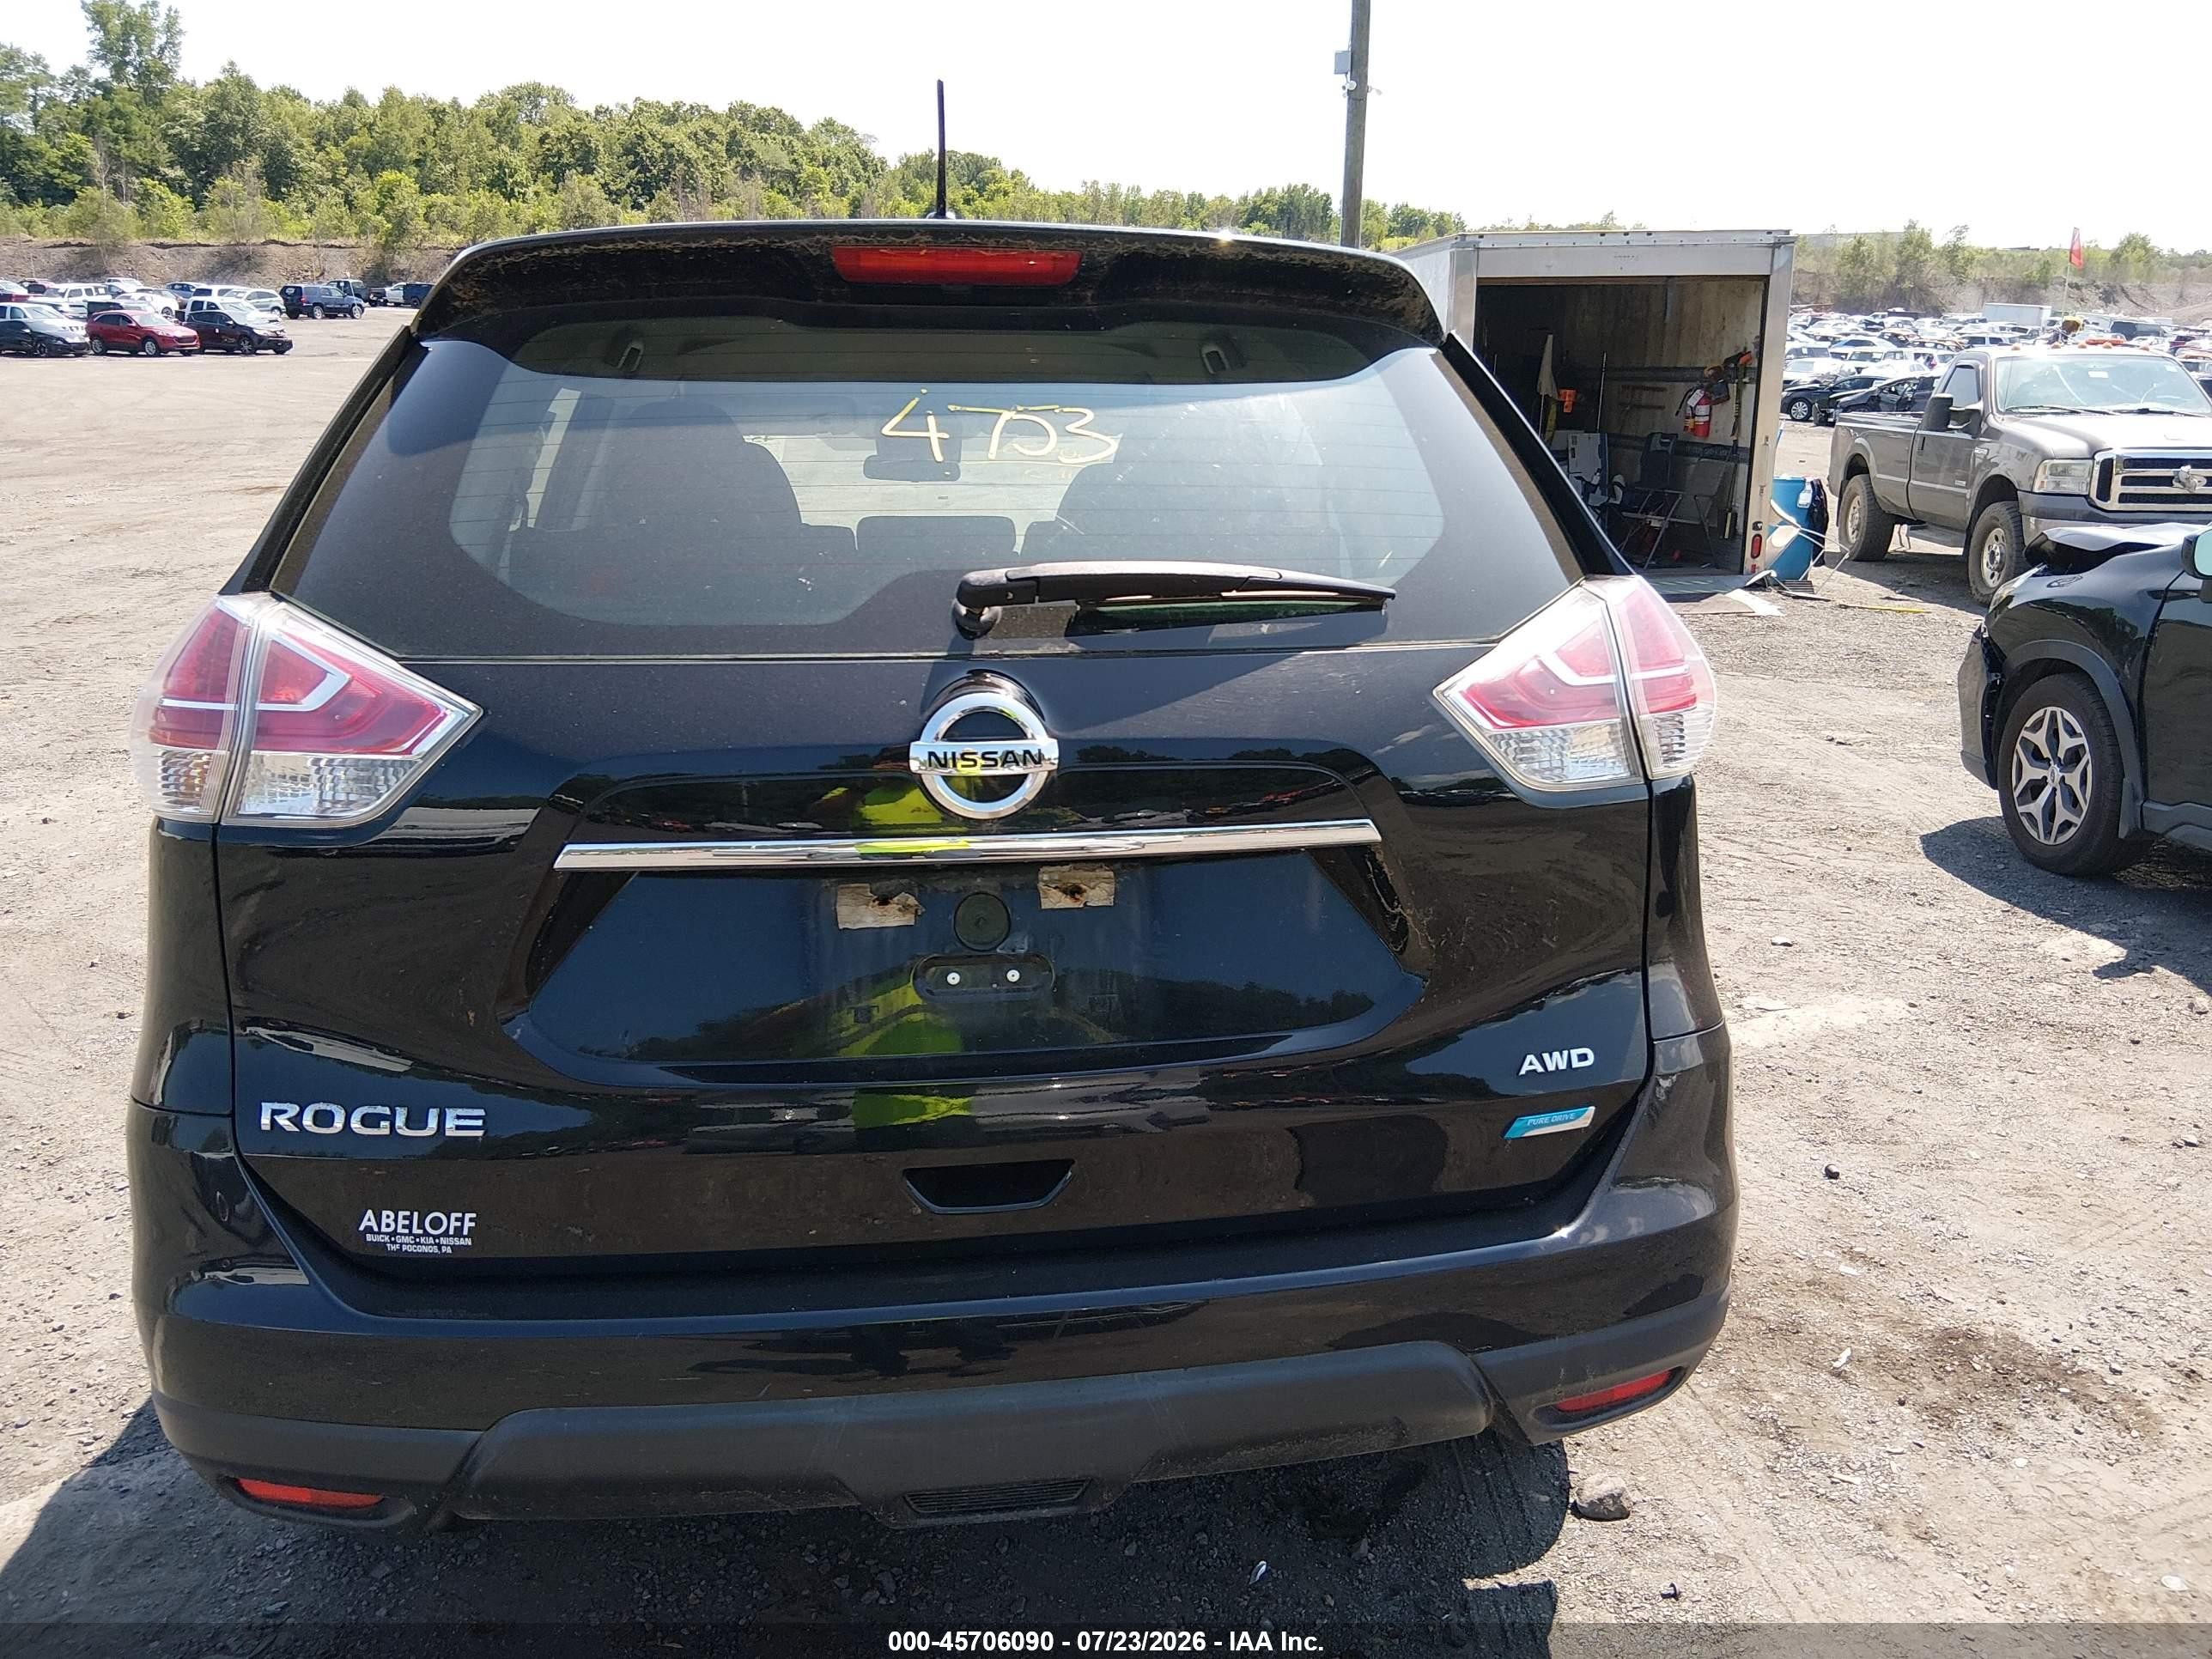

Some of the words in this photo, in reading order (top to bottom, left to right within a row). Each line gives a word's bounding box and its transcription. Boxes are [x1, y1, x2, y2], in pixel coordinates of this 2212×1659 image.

[927, 748, 1042, 769] NISSAN
[1518, 1048, 1595, 1076] AWD
[260, 1102, 486, 1137] ROGUE
[1528, 1116, 1551, 1127] PURE
[1551, 1112, 1577, 1122] DRIVE
[358, 1209, 477, 1235] ABELOFF
